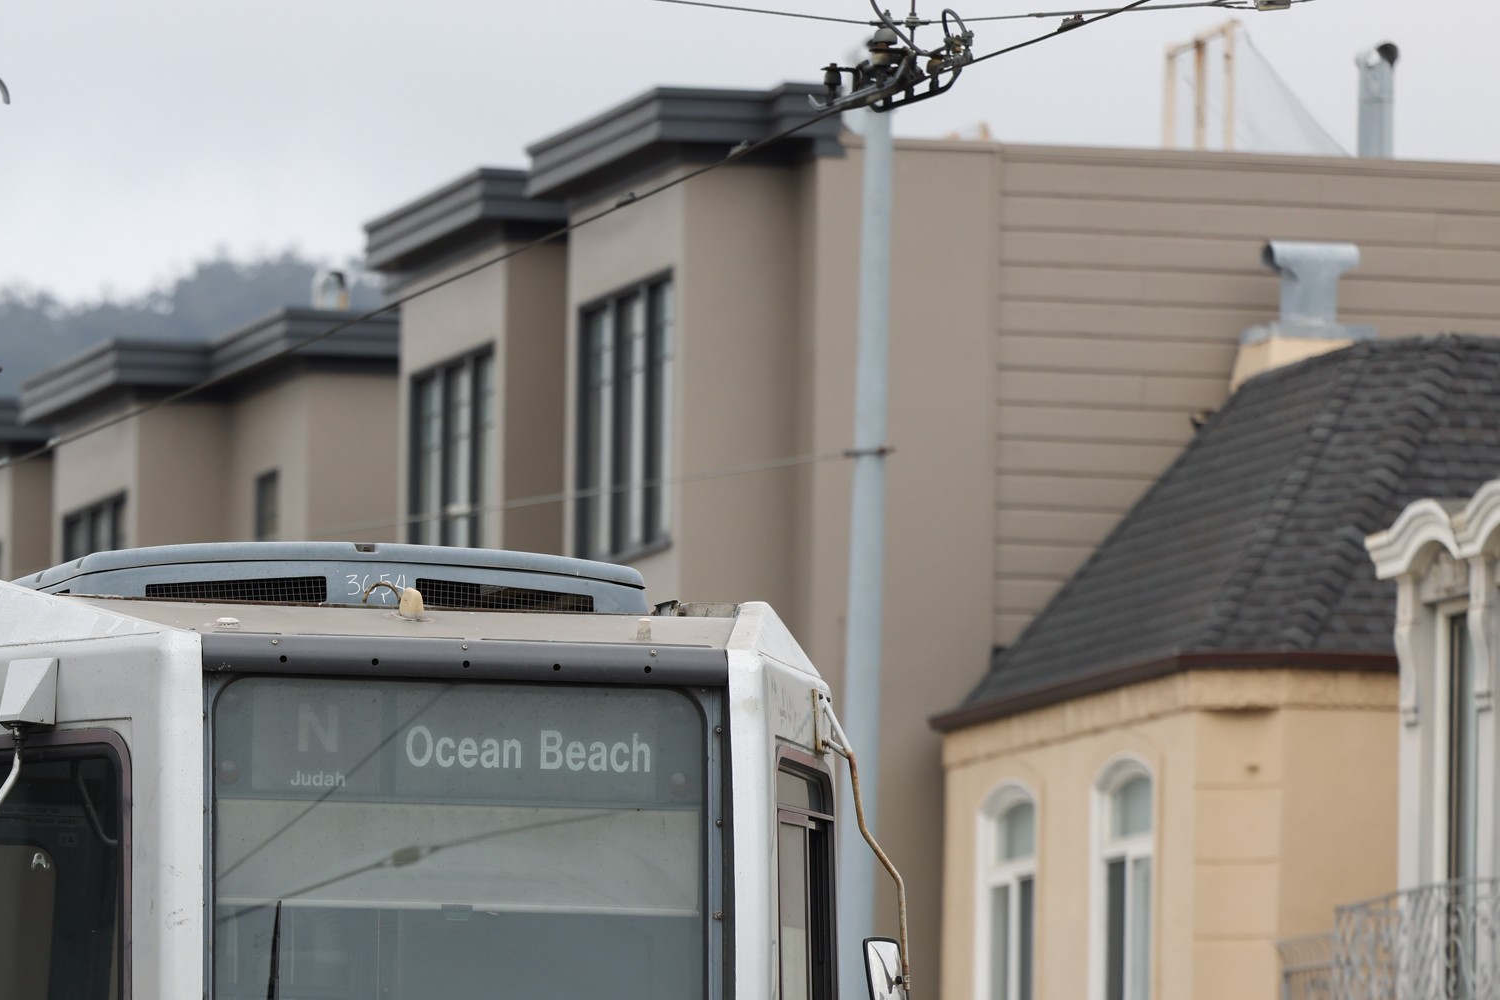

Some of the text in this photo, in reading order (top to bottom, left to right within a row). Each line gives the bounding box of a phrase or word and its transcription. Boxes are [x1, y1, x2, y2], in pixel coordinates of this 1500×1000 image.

[298, 703, 339, 753] N
[405, 725, 652, 773] Ocean Beach
[291, 770, 346, 787] Judah
